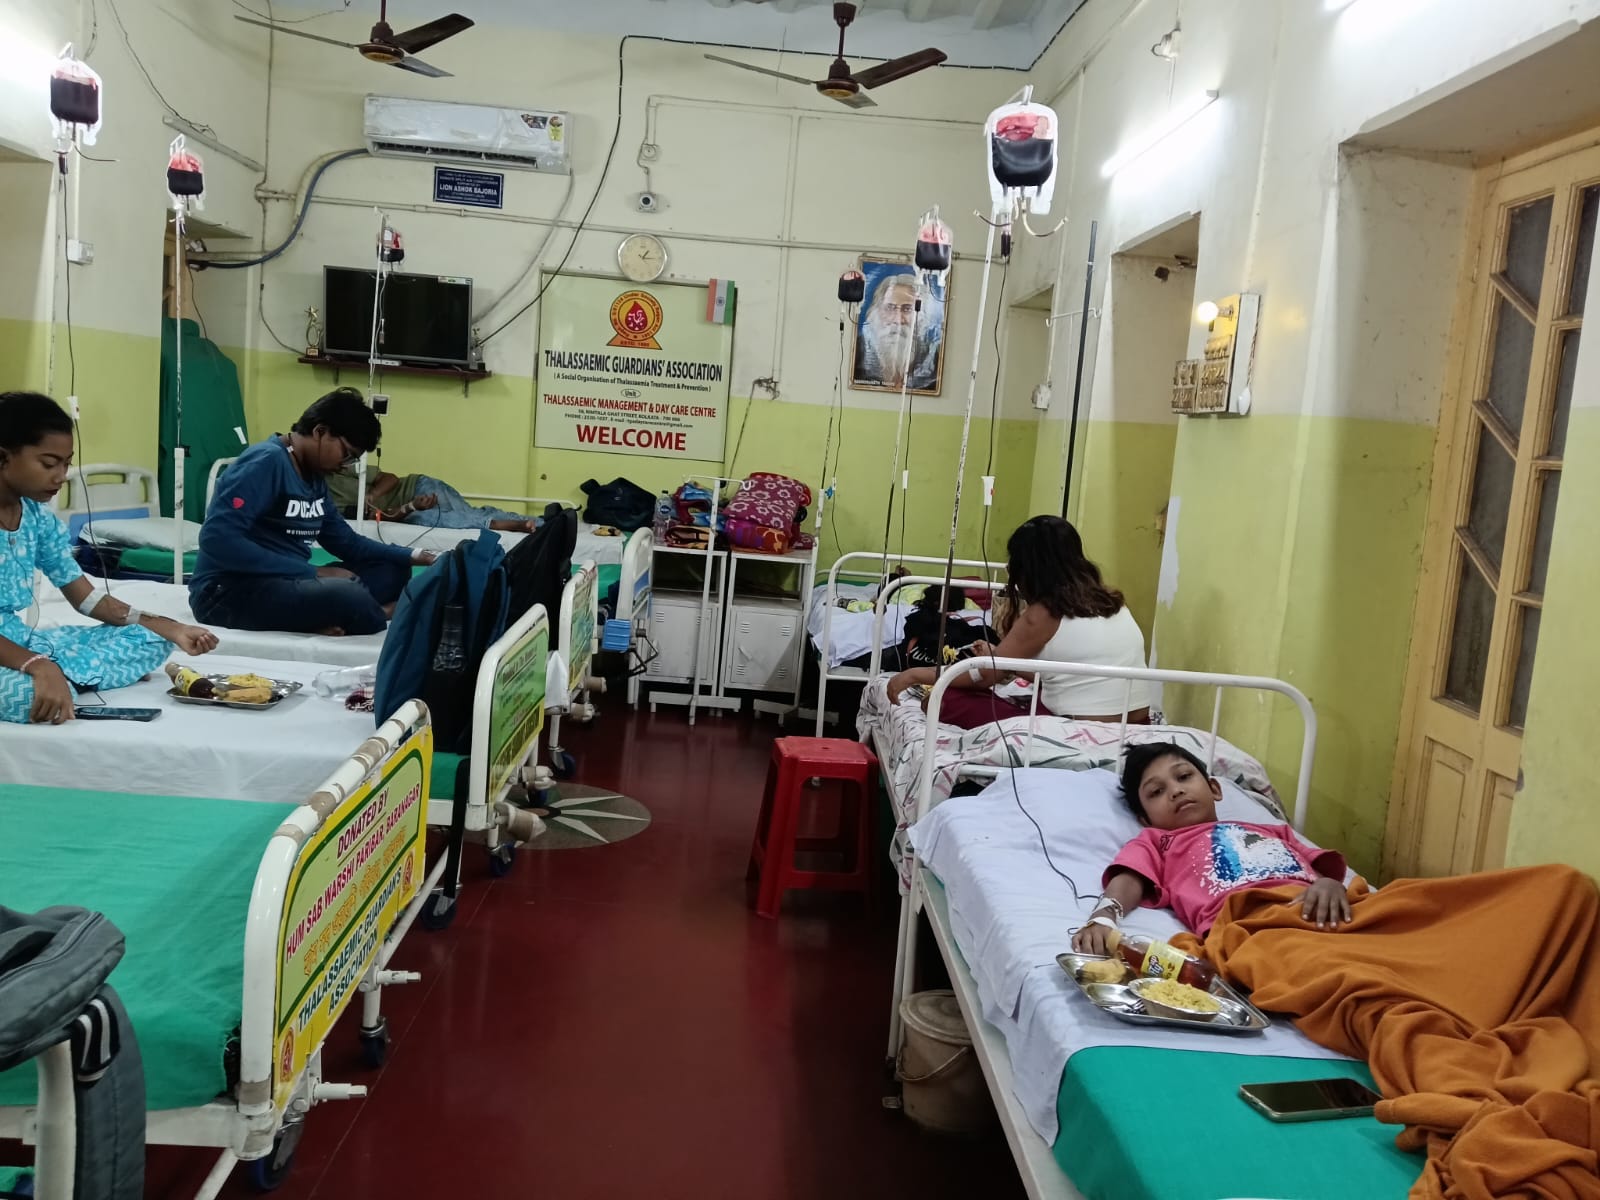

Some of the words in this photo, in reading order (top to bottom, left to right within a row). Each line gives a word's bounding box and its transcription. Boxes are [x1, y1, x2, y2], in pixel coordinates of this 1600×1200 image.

[474, 187, 497, 196] BAJORIA
[545, 350, 610, 372] THALASSAEMIC
[612, 357, 665, 376] GUARDIANS'
[666, 361, 722, 382] ASSOCIATION
[577, 375, 609, 384] Organisation
[617, 377, 650, 387] Thalassaemia
[650, 381, 676, 389] Treatment
[681, 384, 709, 392] Prevention
[544, 394, 595, 408] THALASSAEMIC
[598, 398, 648, 412] MANAGEMENT
[649, 403, 654, 412] &
[656, 404, 670, 414] DAY
[671, 405, 689, 416] CARE
[690, 407, 716, 418] CENTRE
[576, 424, 687, 451] WELCOME
[337, 800, 377, 860] DONATED
[378, 788, 390, 814] BY
[286, 921, 305, 964] HUM
[306, 896, 323, 934] SAB
[324, 861, 355, 910] WARSHI
[386, 783, 420, 835] BARANAGAR
[299, 924, 363, 1027] THALASSAEMIC
[364, 866, 402, 934] GUARDIAN'S
[328, 928, 378, 1015] ASSOCIATION
